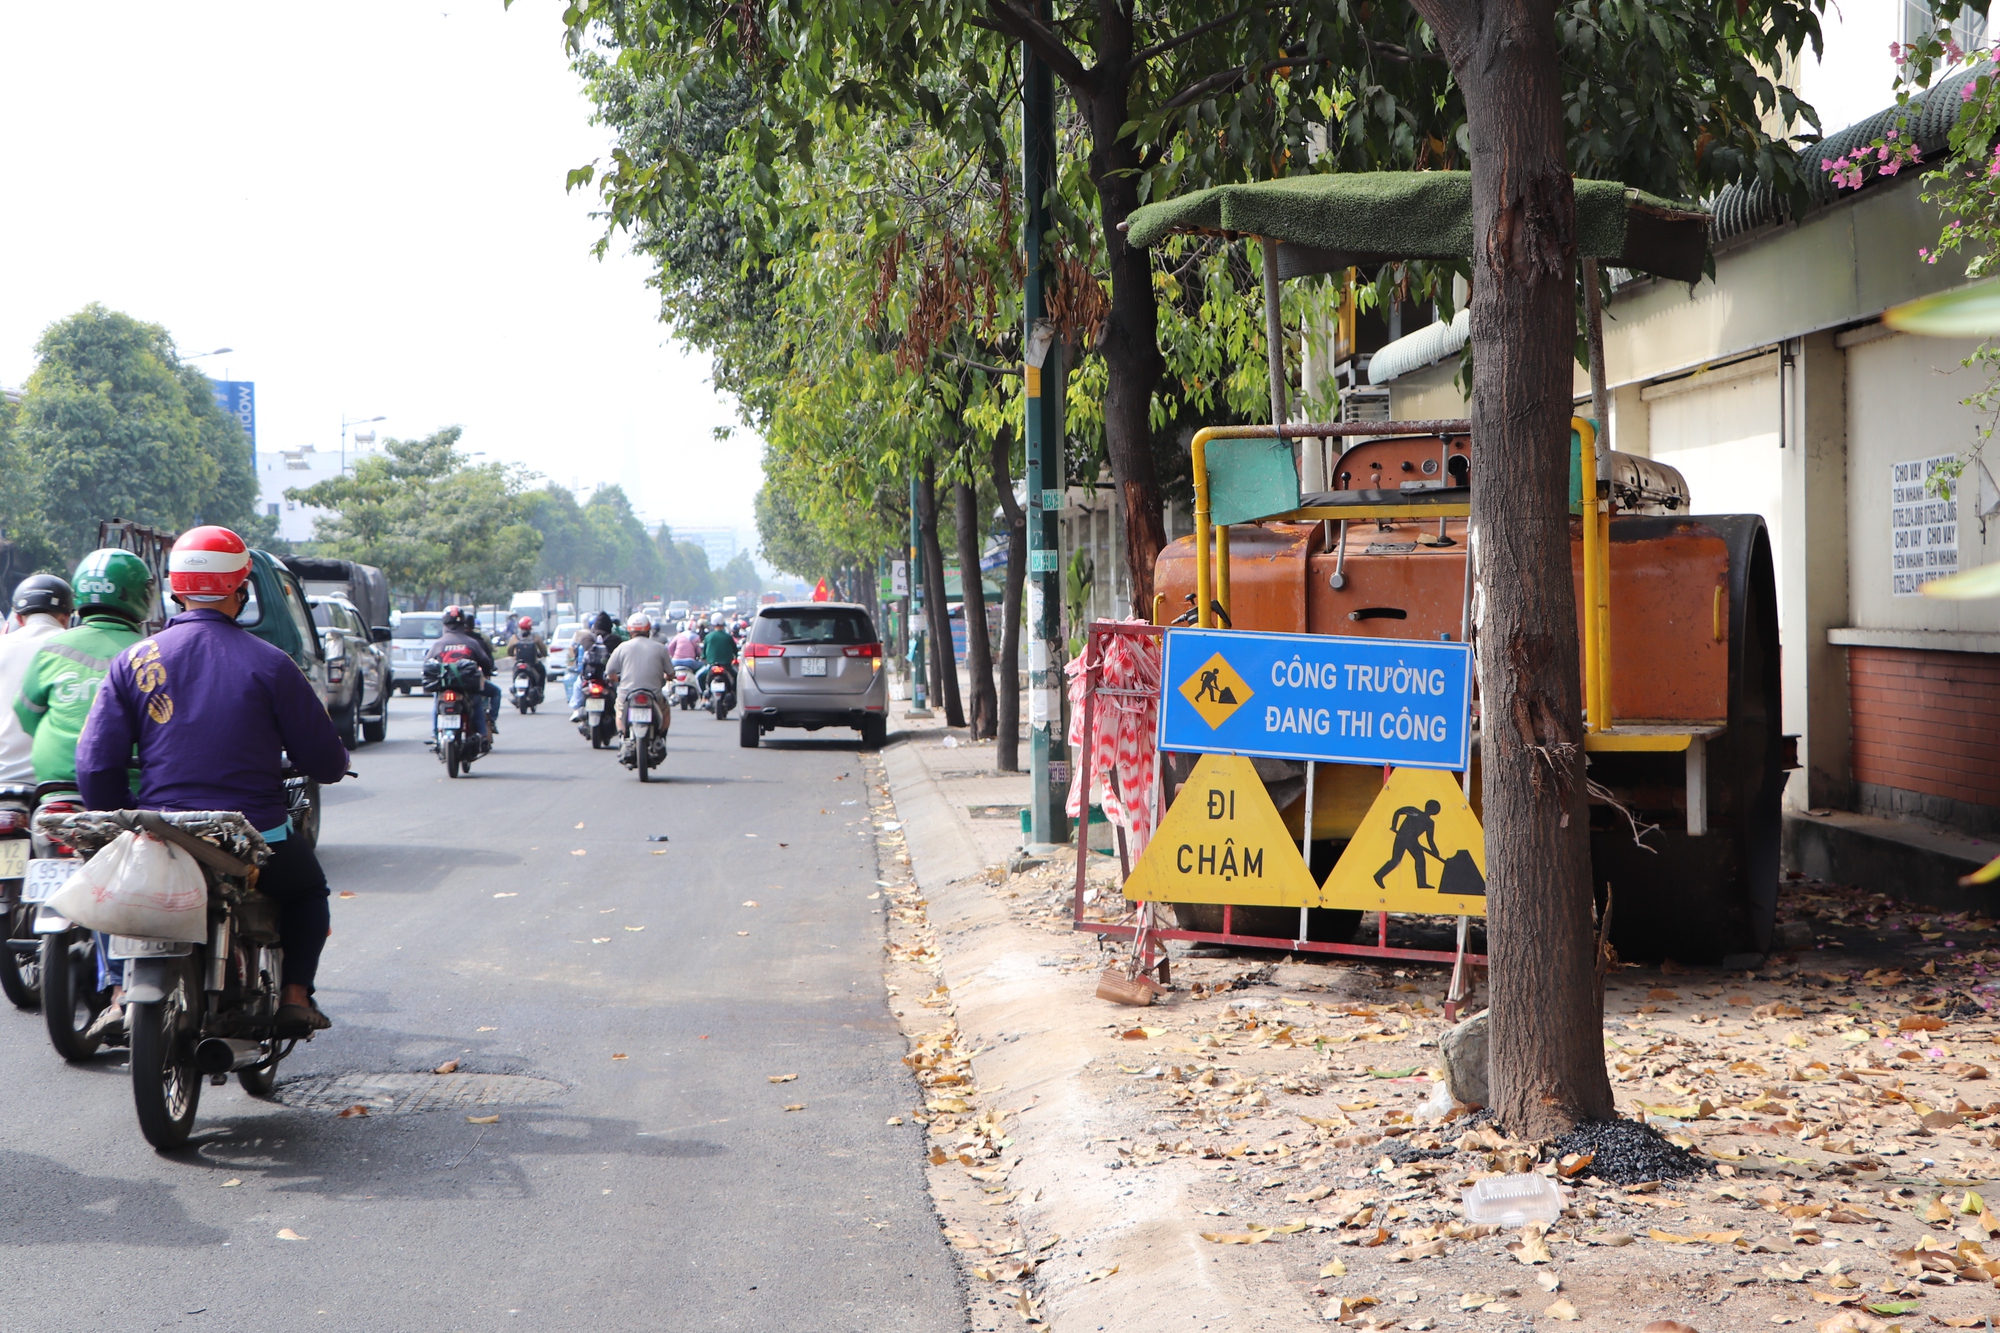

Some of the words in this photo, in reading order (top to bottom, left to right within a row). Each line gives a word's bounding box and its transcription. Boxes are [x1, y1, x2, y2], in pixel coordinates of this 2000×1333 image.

[1895, 463, 1908, 482] CHO
[1910, 462, 1921, 480] VAY
[1895, 531, 1908, 549] CHO
[1910, 529, 1921, 547] VAY
[1927, 527, 1941, 545] CHO
[1943, 526, 1955, 543] VAY
[78, 578, 116, 594] Grab
[444, 643, 467, 652] msi
[54, 671, 102, 702] Gr
[1271, 654, 1337, 690] CÔNG
[1344, 659, 1446, 697] TRƯỜNG
[1264, 706, 1331, 736] ĐANG
[1337, 709, 1374, 738] THI
[1379, 706, 1448, 743] CÔNG
[1207, 789, 1235, 820] ĐI
[1176, 837, 1264, 882] CHẬM
